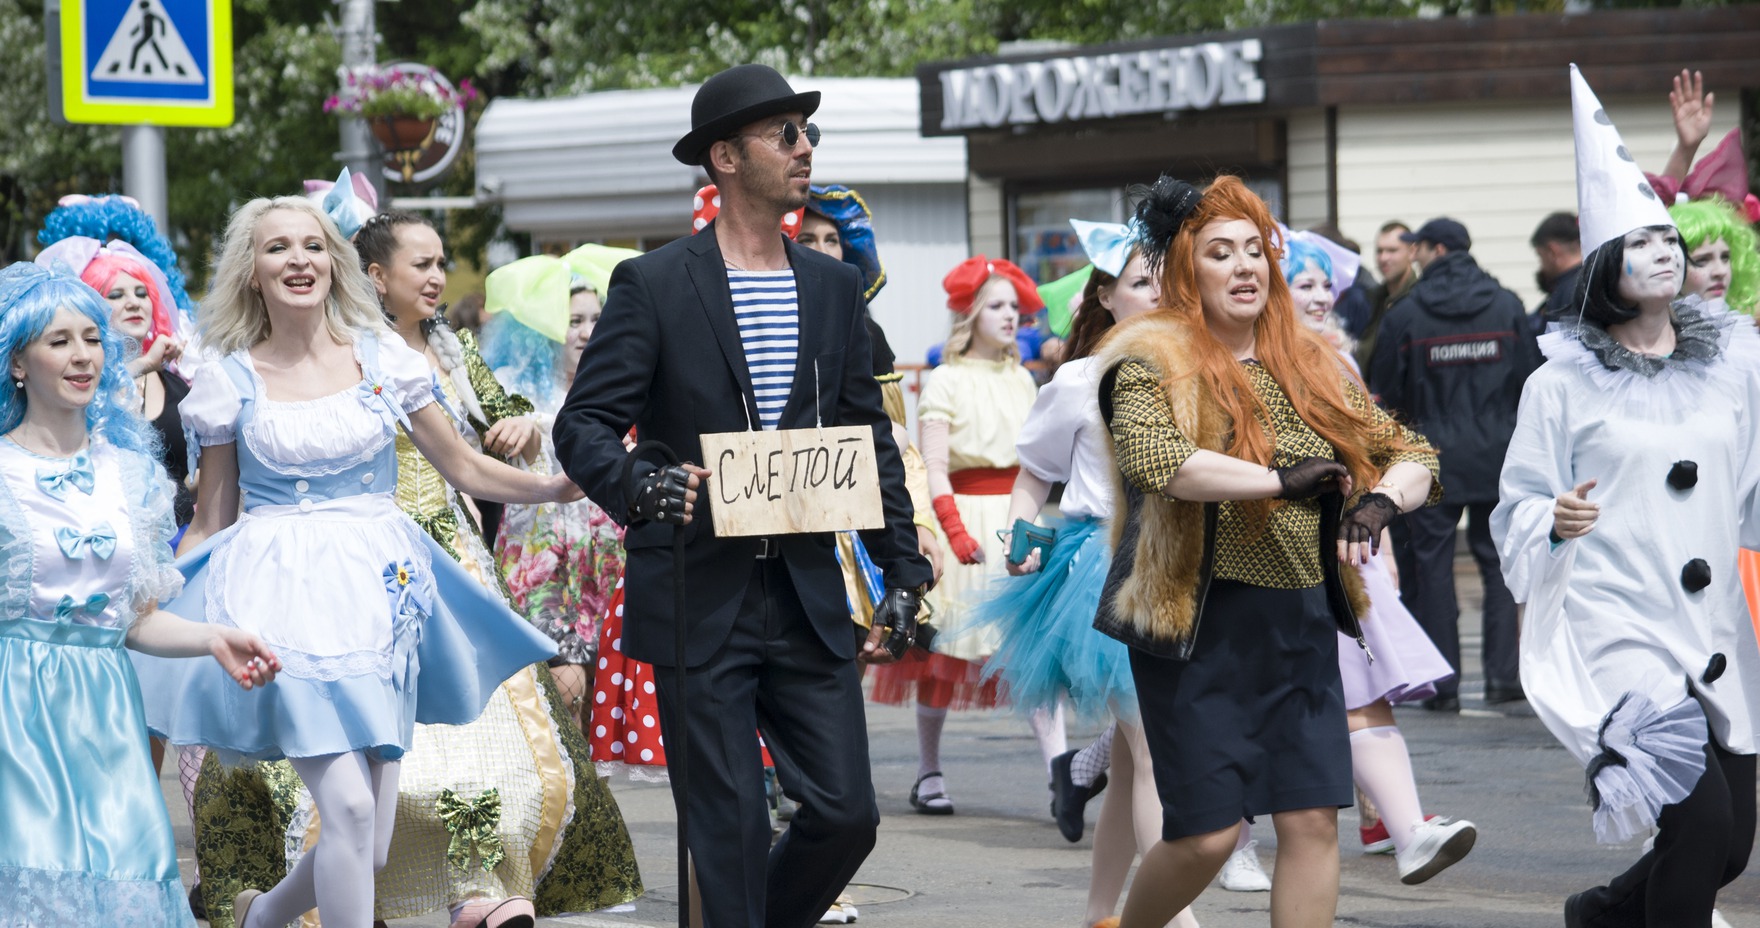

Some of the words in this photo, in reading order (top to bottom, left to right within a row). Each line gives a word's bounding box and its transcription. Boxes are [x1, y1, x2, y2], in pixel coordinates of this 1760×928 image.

[939, 38, 1265, 130] МОРОЖЕНОЕ
[1430, 340, 1498, 362] ПОЛИЦИЯ
[719, 437, 862, 504] СЛЕПОЙ
